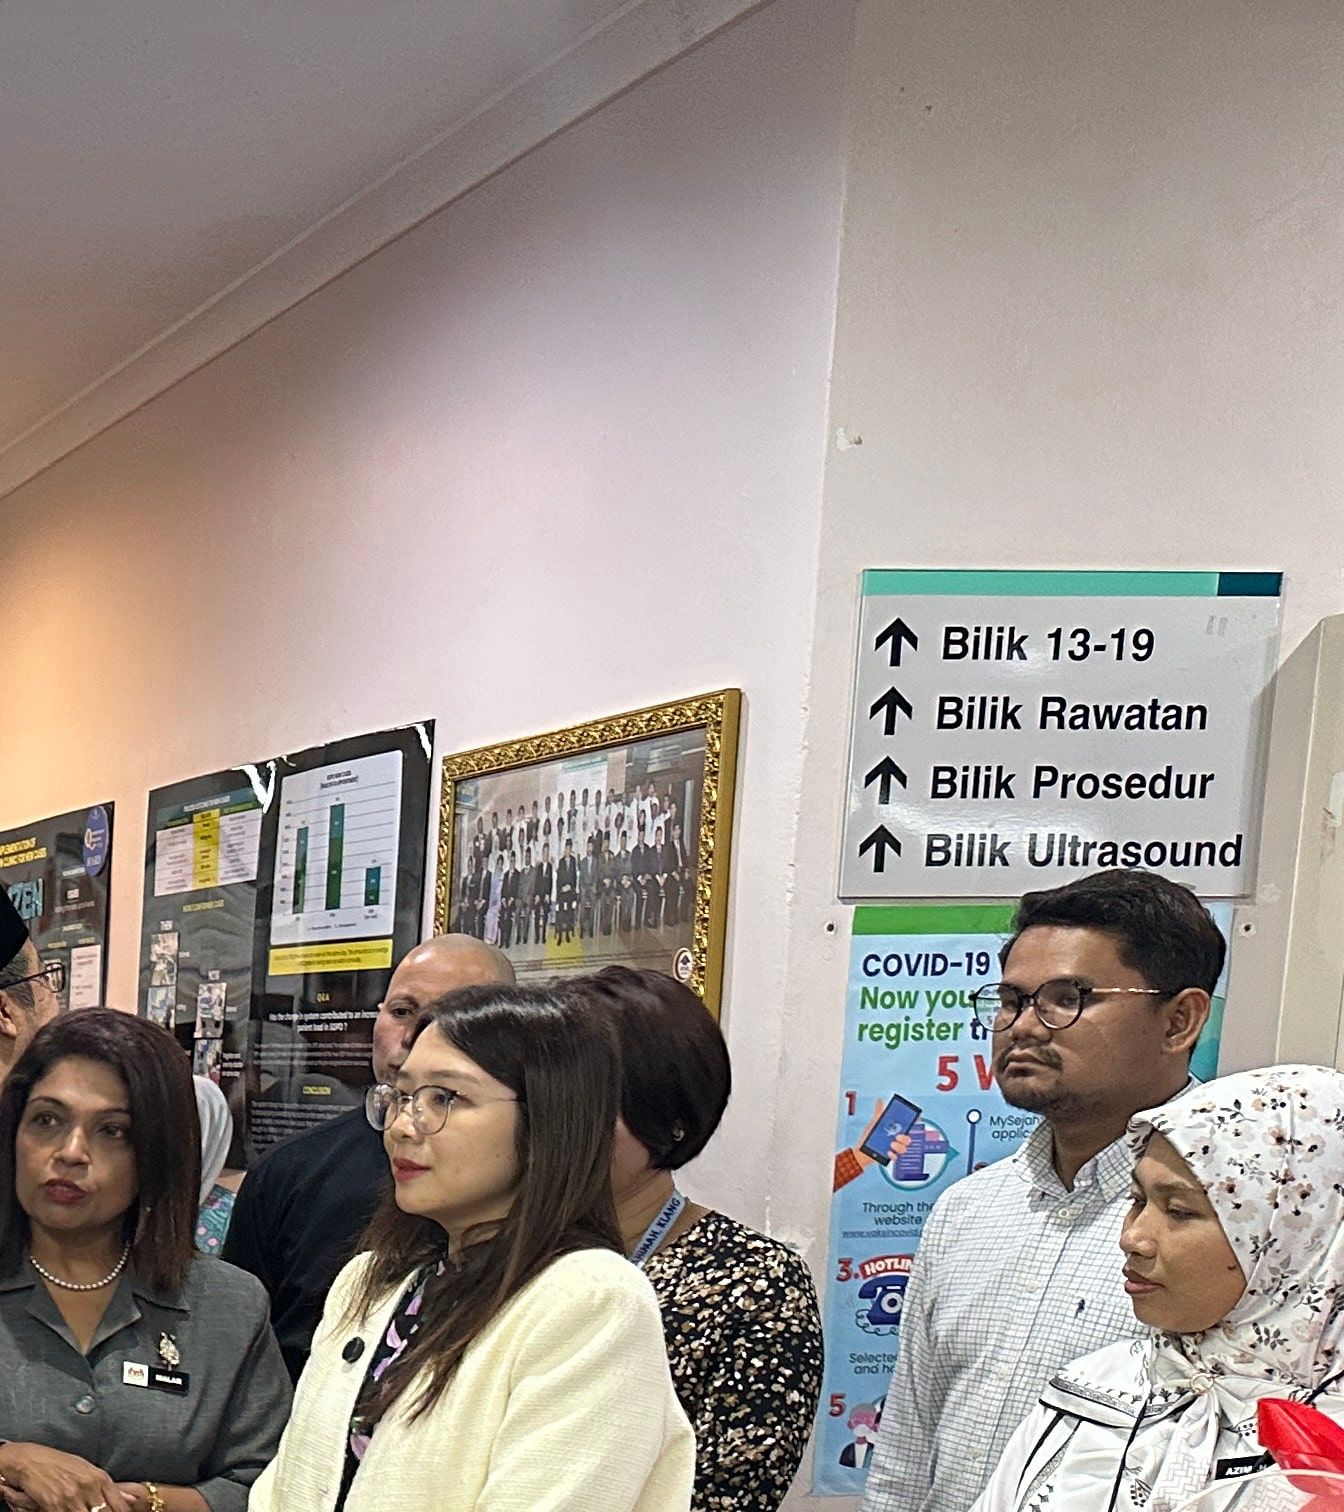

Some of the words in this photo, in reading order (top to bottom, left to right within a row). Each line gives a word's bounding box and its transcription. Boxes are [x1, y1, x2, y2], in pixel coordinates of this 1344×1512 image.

[943, 627, 1028, 660] Bilik
[1048, 628, 1154, 661] 13-19
[937, 696, 1022, 729] Bilik
[1040, 697, 1207, 730] Rawatan
[931, 765, 1016, 799] Bilik
[1033, 766, 1214, 799] Prosedur
[924, 834, 1010, 867] Bilik
[1028, 834, 1243, 867] Ultrasound
[863, 951, 990, 977] COVID-19
[860, 986, 914, 1009] Now
[926, 989, 974, 1016] you
[858, 1016, 964, 1049] register
[936, 1056, 960, 1091] 5
[845, 1091, 856, 1116] 1
[863, 1202, 913, 1215] Through
[874, 1215, 922, 1225] website
[864, 1258, 912, 1275] HOTLIN
[829, 1394, 846, 1416] 5
